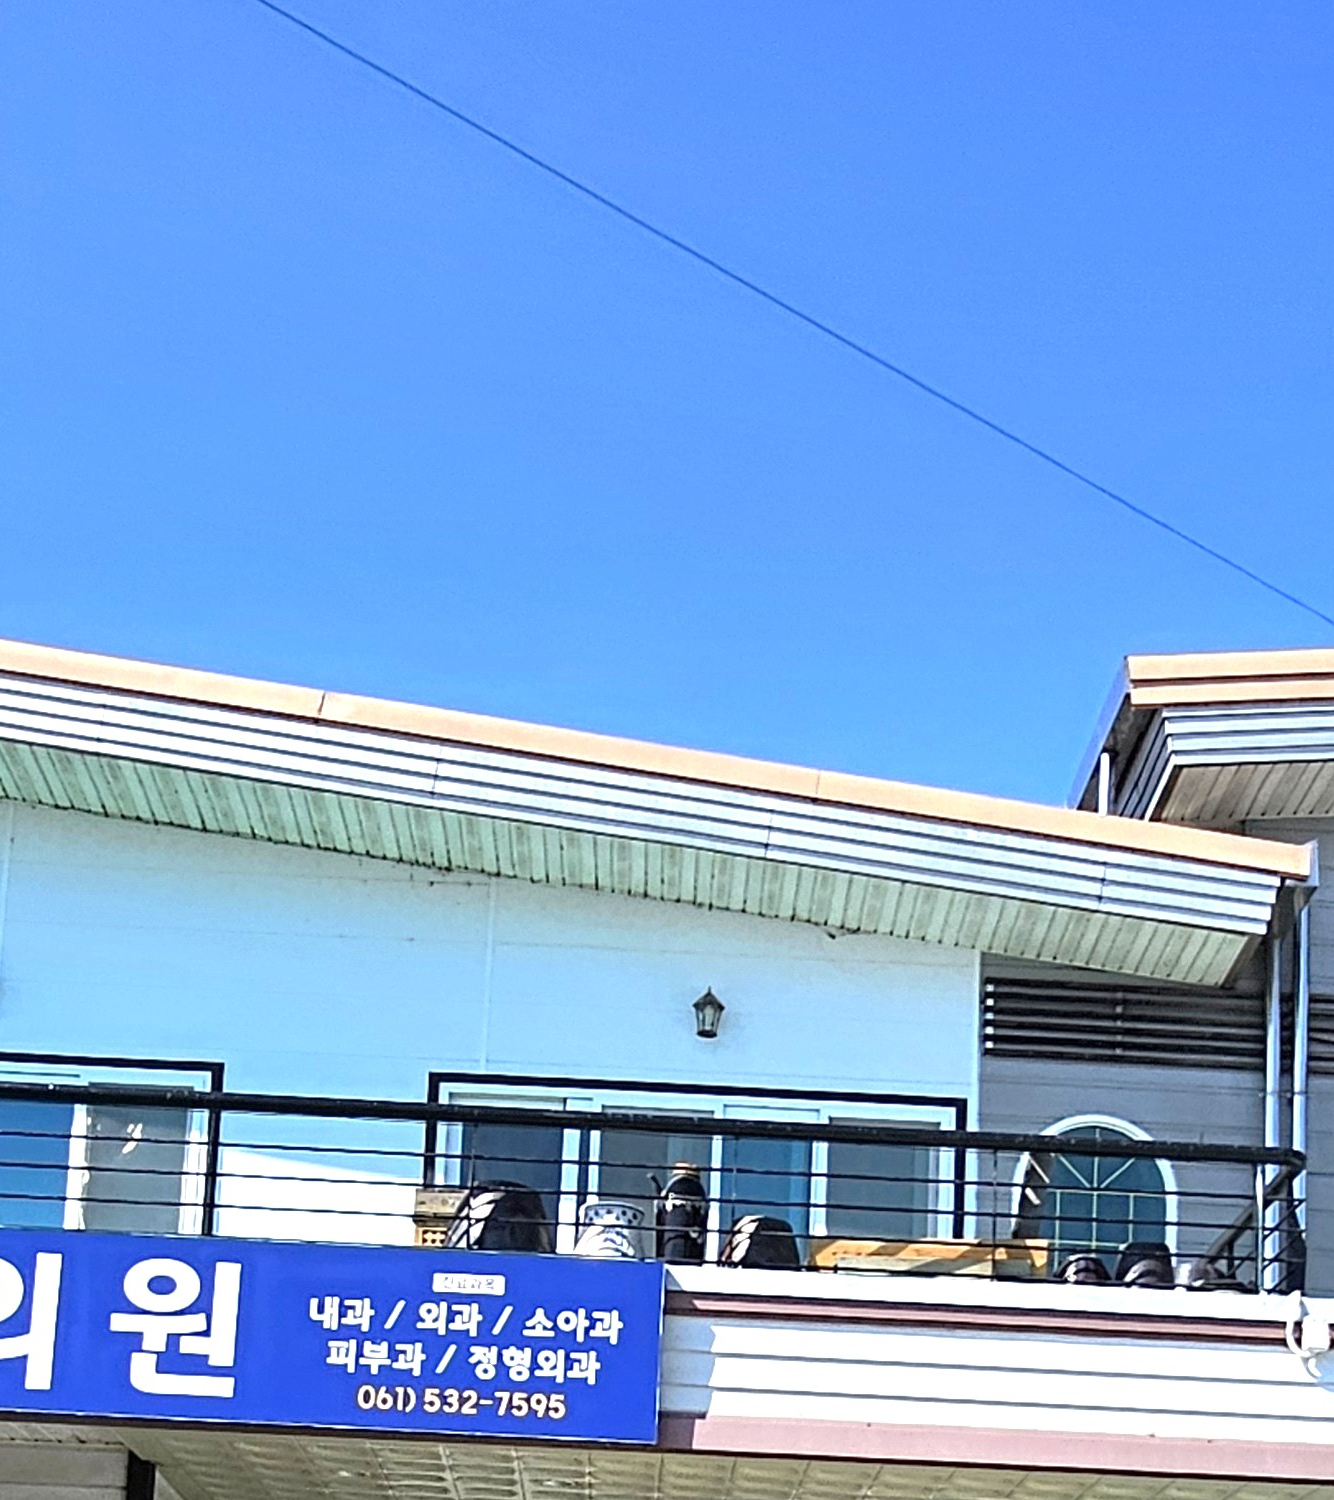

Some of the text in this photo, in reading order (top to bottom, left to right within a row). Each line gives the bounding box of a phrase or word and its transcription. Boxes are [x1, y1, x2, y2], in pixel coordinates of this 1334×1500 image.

[309, 1296, 375, 1332] 내과
[416, 1300, 483, 1337] 외과
[522, 1307, 624, 1345] 소아과
[325, 1338, 427, 1376] 피부과
[468, 1345, 601, 1385] 정형외과
[357, 1385, 566, 1420] 061) 532-7595
